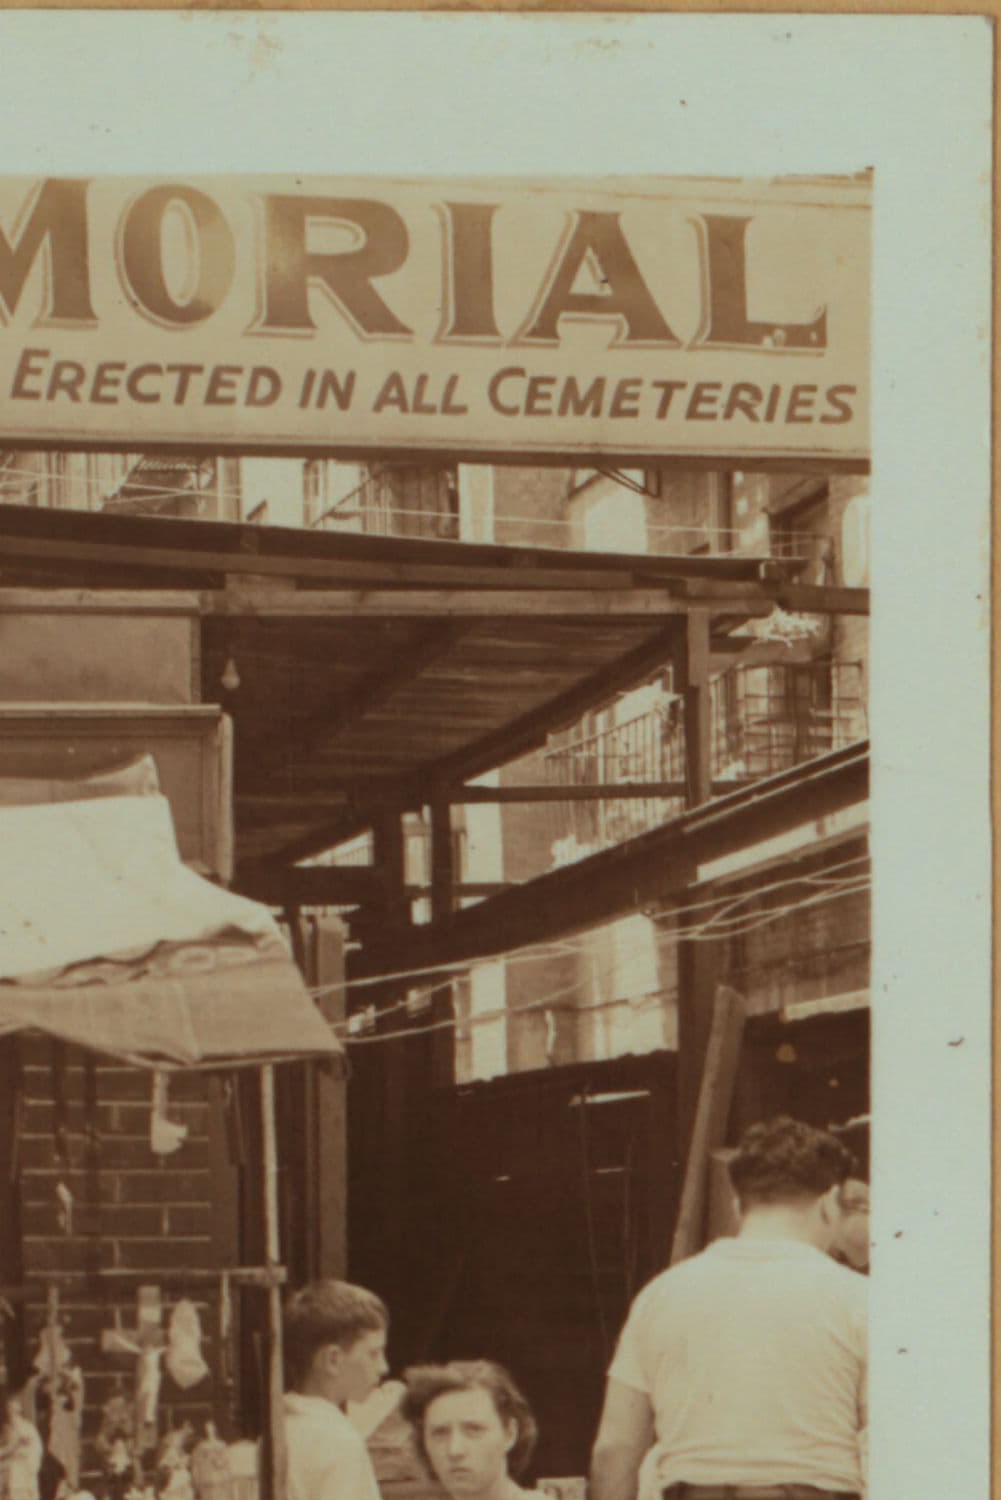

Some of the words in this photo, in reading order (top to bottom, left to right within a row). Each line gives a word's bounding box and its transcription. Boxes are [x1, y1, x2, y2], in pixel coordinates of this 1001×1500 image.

[9, 349, 283, 406] ERECTED
[299, 369, 356, 411] IN
[372, 372, 469, 417] ALL
[487, 367, 858, 425] CEMETERIES
